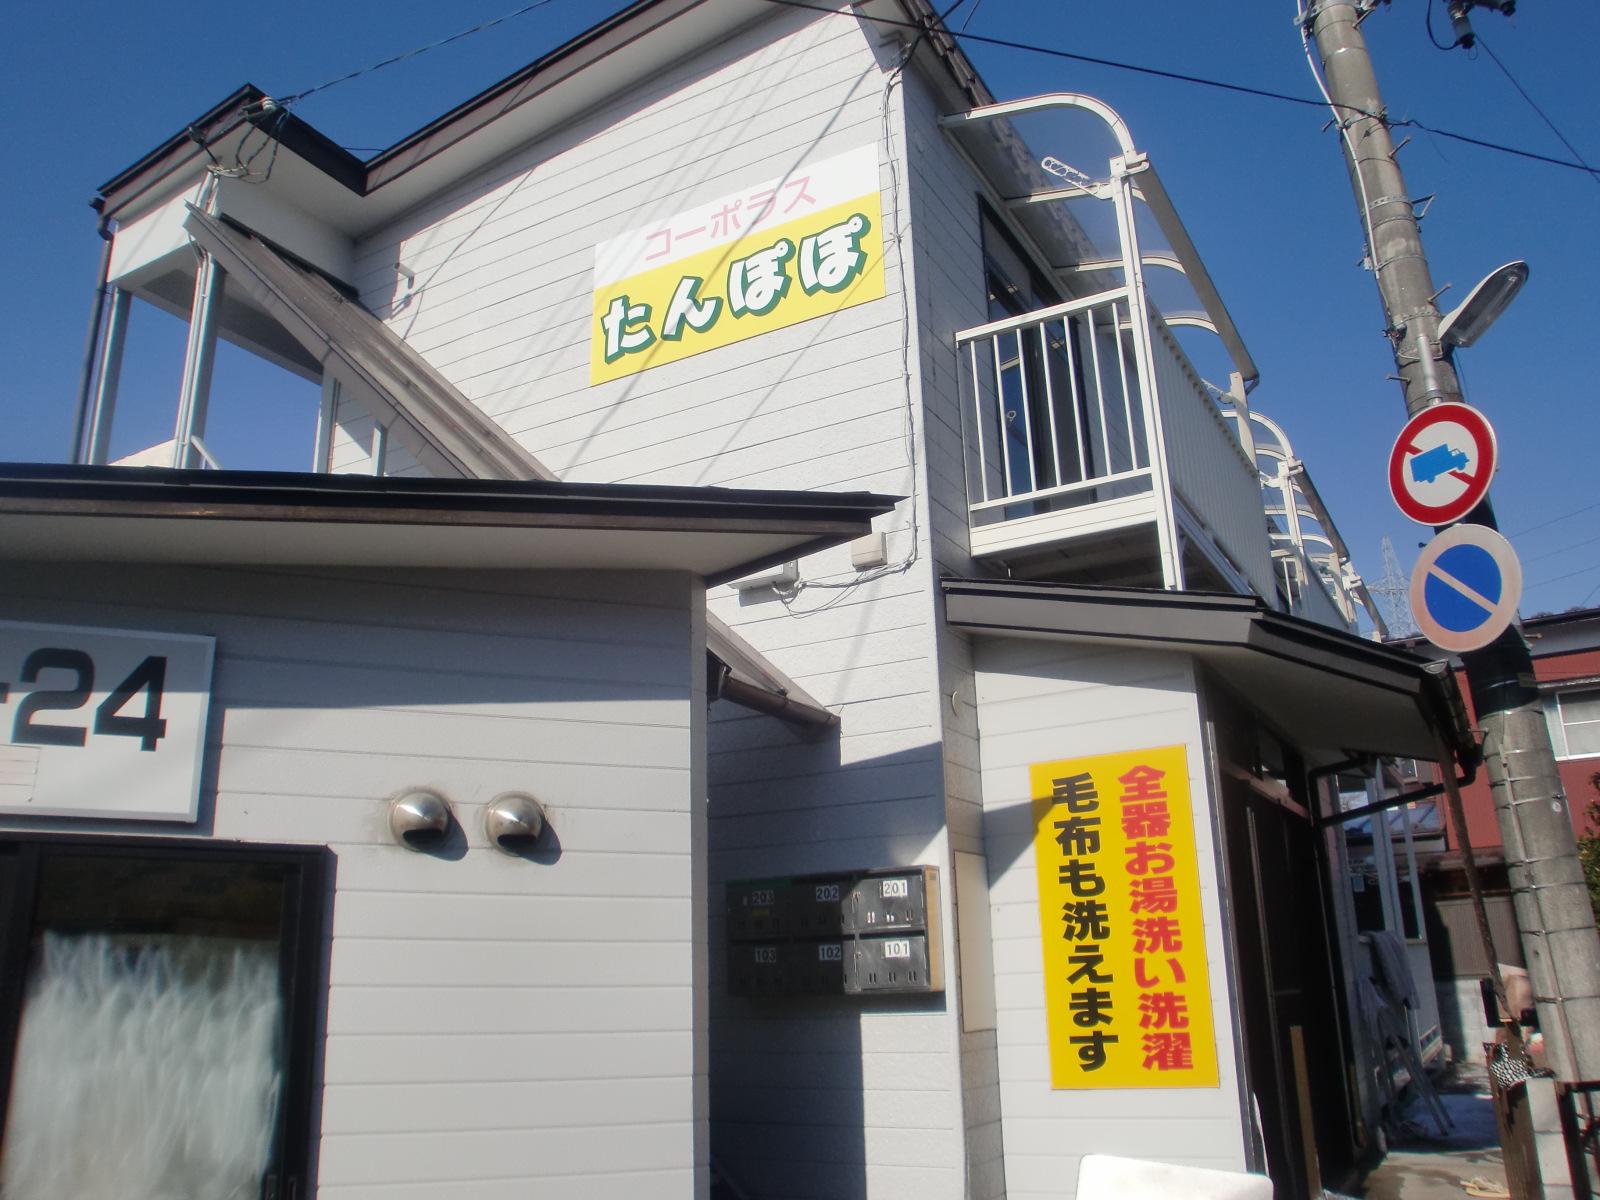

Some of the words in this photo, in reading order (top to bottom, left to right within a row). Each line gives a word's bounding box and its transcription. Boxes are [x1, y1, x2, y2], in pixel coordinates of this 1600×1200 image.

[645, 175, 817, 262] コーポラス
[600, 212, 872, 365] たんぽぽ
[816, 886, 839, 900] 202
[883, 881, 908, 896] 201
[1051, 772, 1120, 1073] 毛布も洗えます
[1116, 764, 1194, 1072] 全器お湯洗い洗濯
[820, 945, 841, 960] 102
[886, 942, 910, 957] 101
